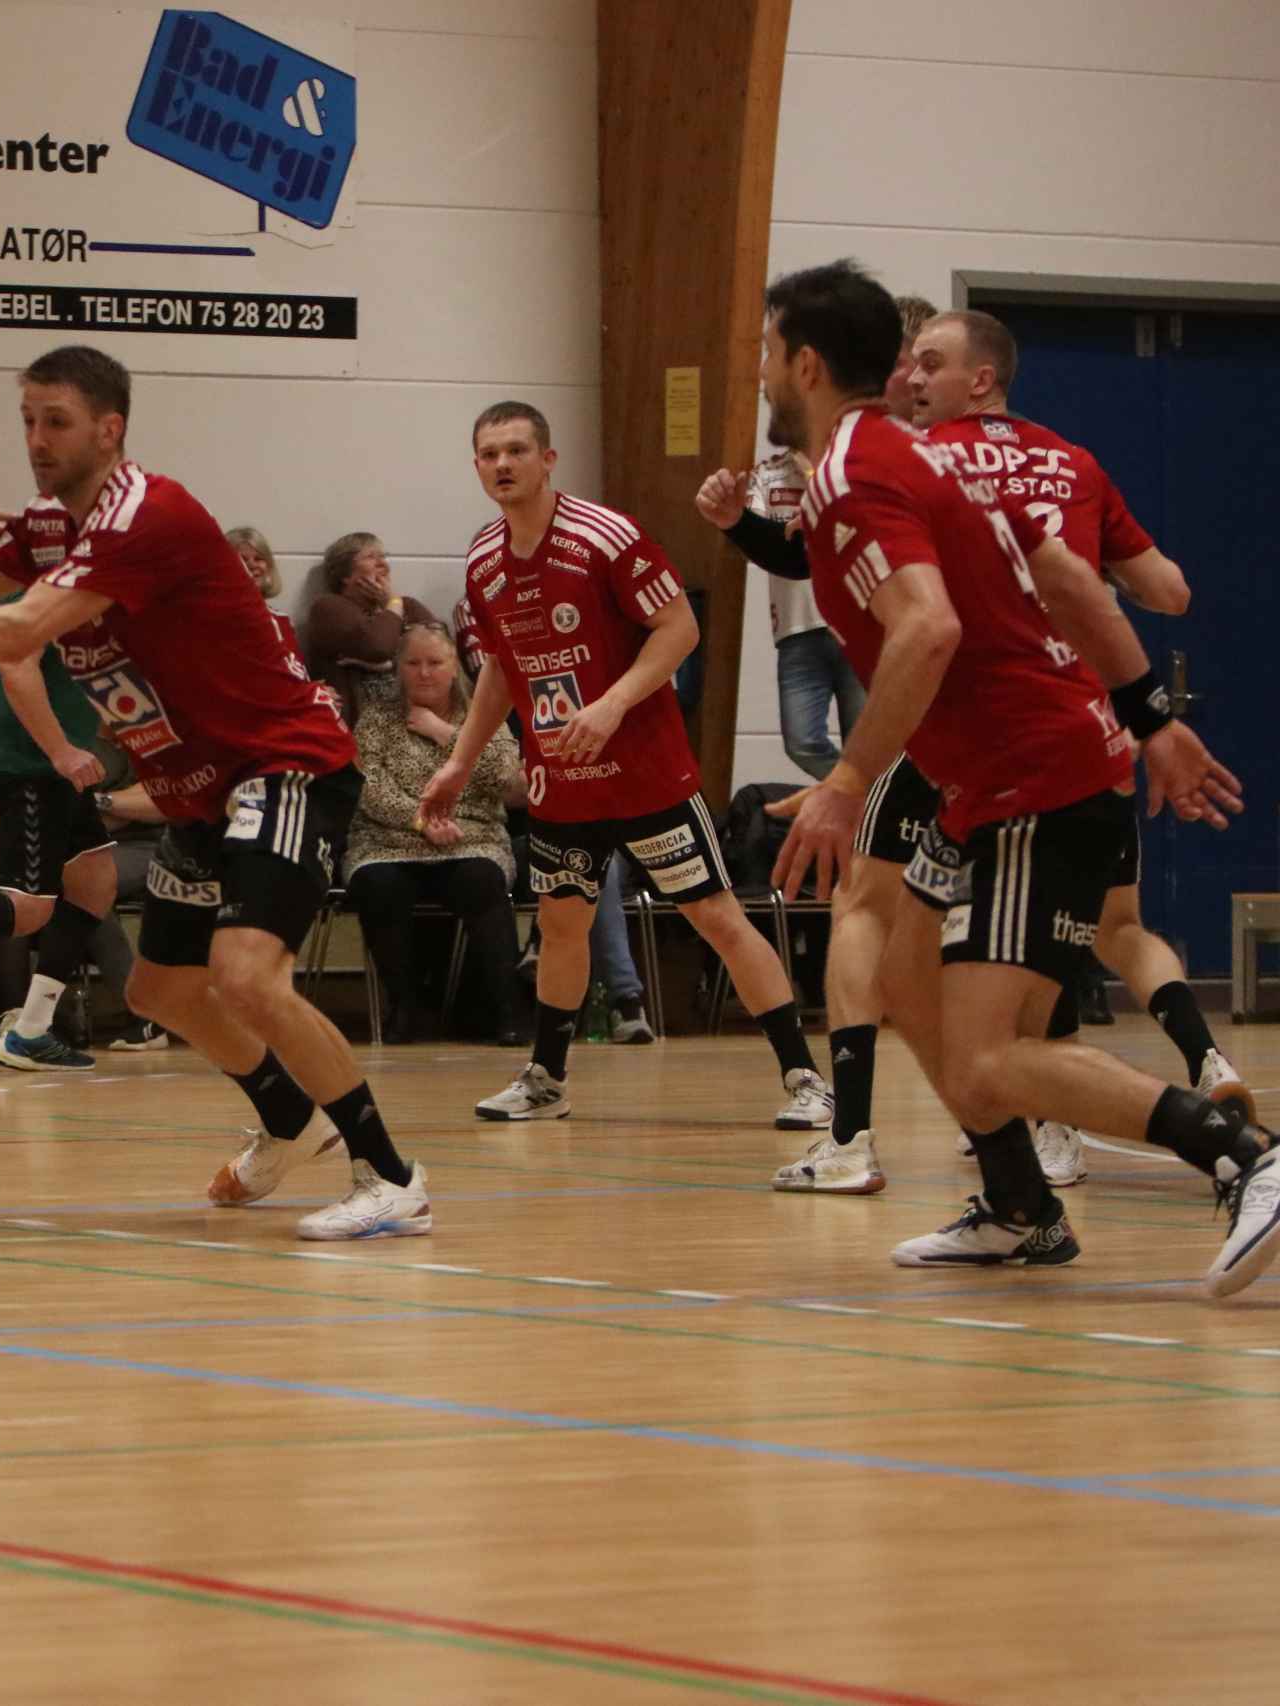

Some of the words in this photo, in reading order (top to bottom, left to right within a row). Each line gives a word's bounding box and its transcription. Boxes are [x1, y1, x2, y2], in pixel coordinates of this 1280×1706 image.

[163, 14, 280, 111] Bad
[282, 77, 326, 137] &
[145, 69, 337, 202] Energi
[80, 295, 192, 326] TELEFON
[199, 300, 226, 327] 75
[232, 302, 259, 328] 28
[265, 303, 292, 329] 20
[298, 304, 325, 331] 23
[1004, 477, 1072, 500] STAD
